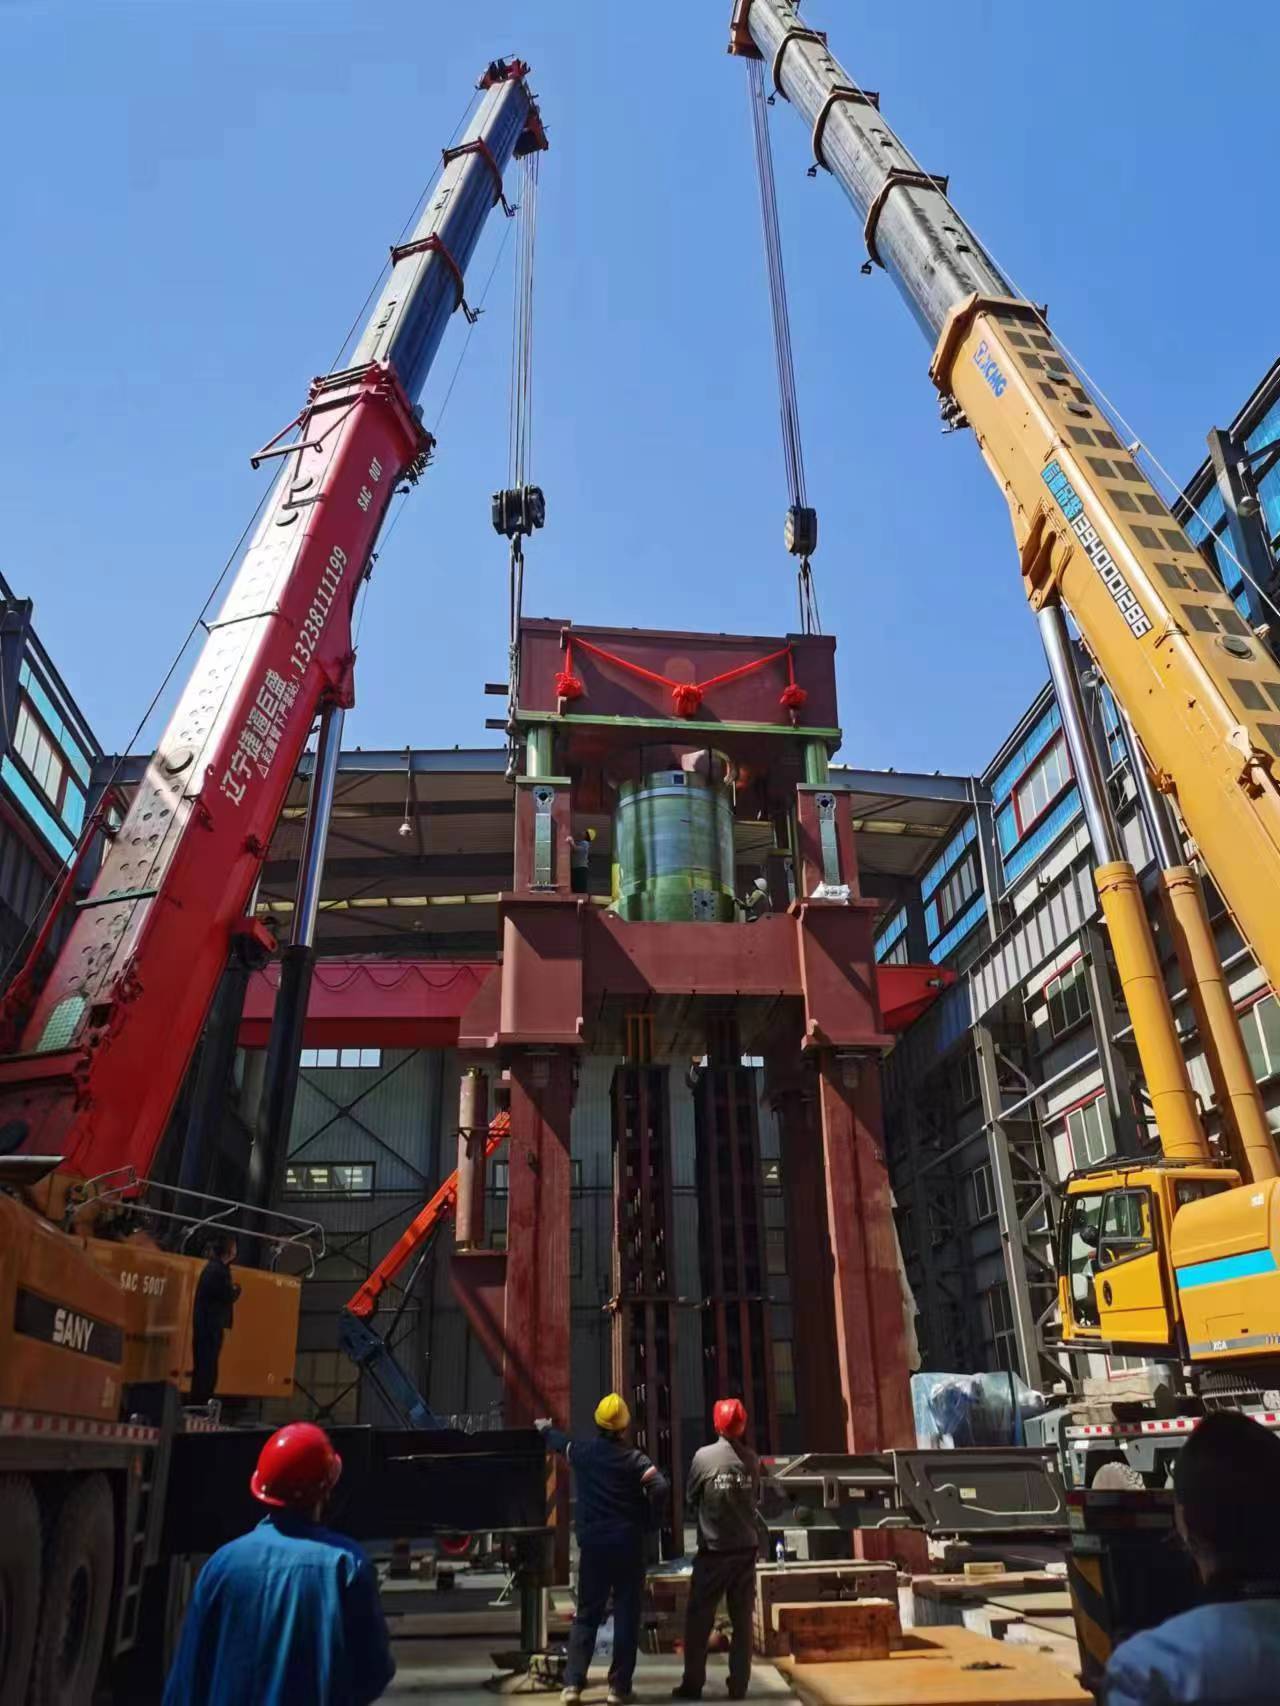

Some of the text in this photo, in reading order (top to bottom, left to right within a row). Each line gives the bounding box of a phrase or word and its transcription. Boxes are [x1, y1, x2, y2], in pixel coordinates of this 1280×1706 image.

[357, 486, 372, 511] SAC
[1070, 511, 1154, 639] 13940001286
[219, 545, 347, 806] 辽宁捷通巨盛 13238111199
[120, 1271, 167, 1296] SAC 500T
[53, 1308, 94, 1352] SANY
